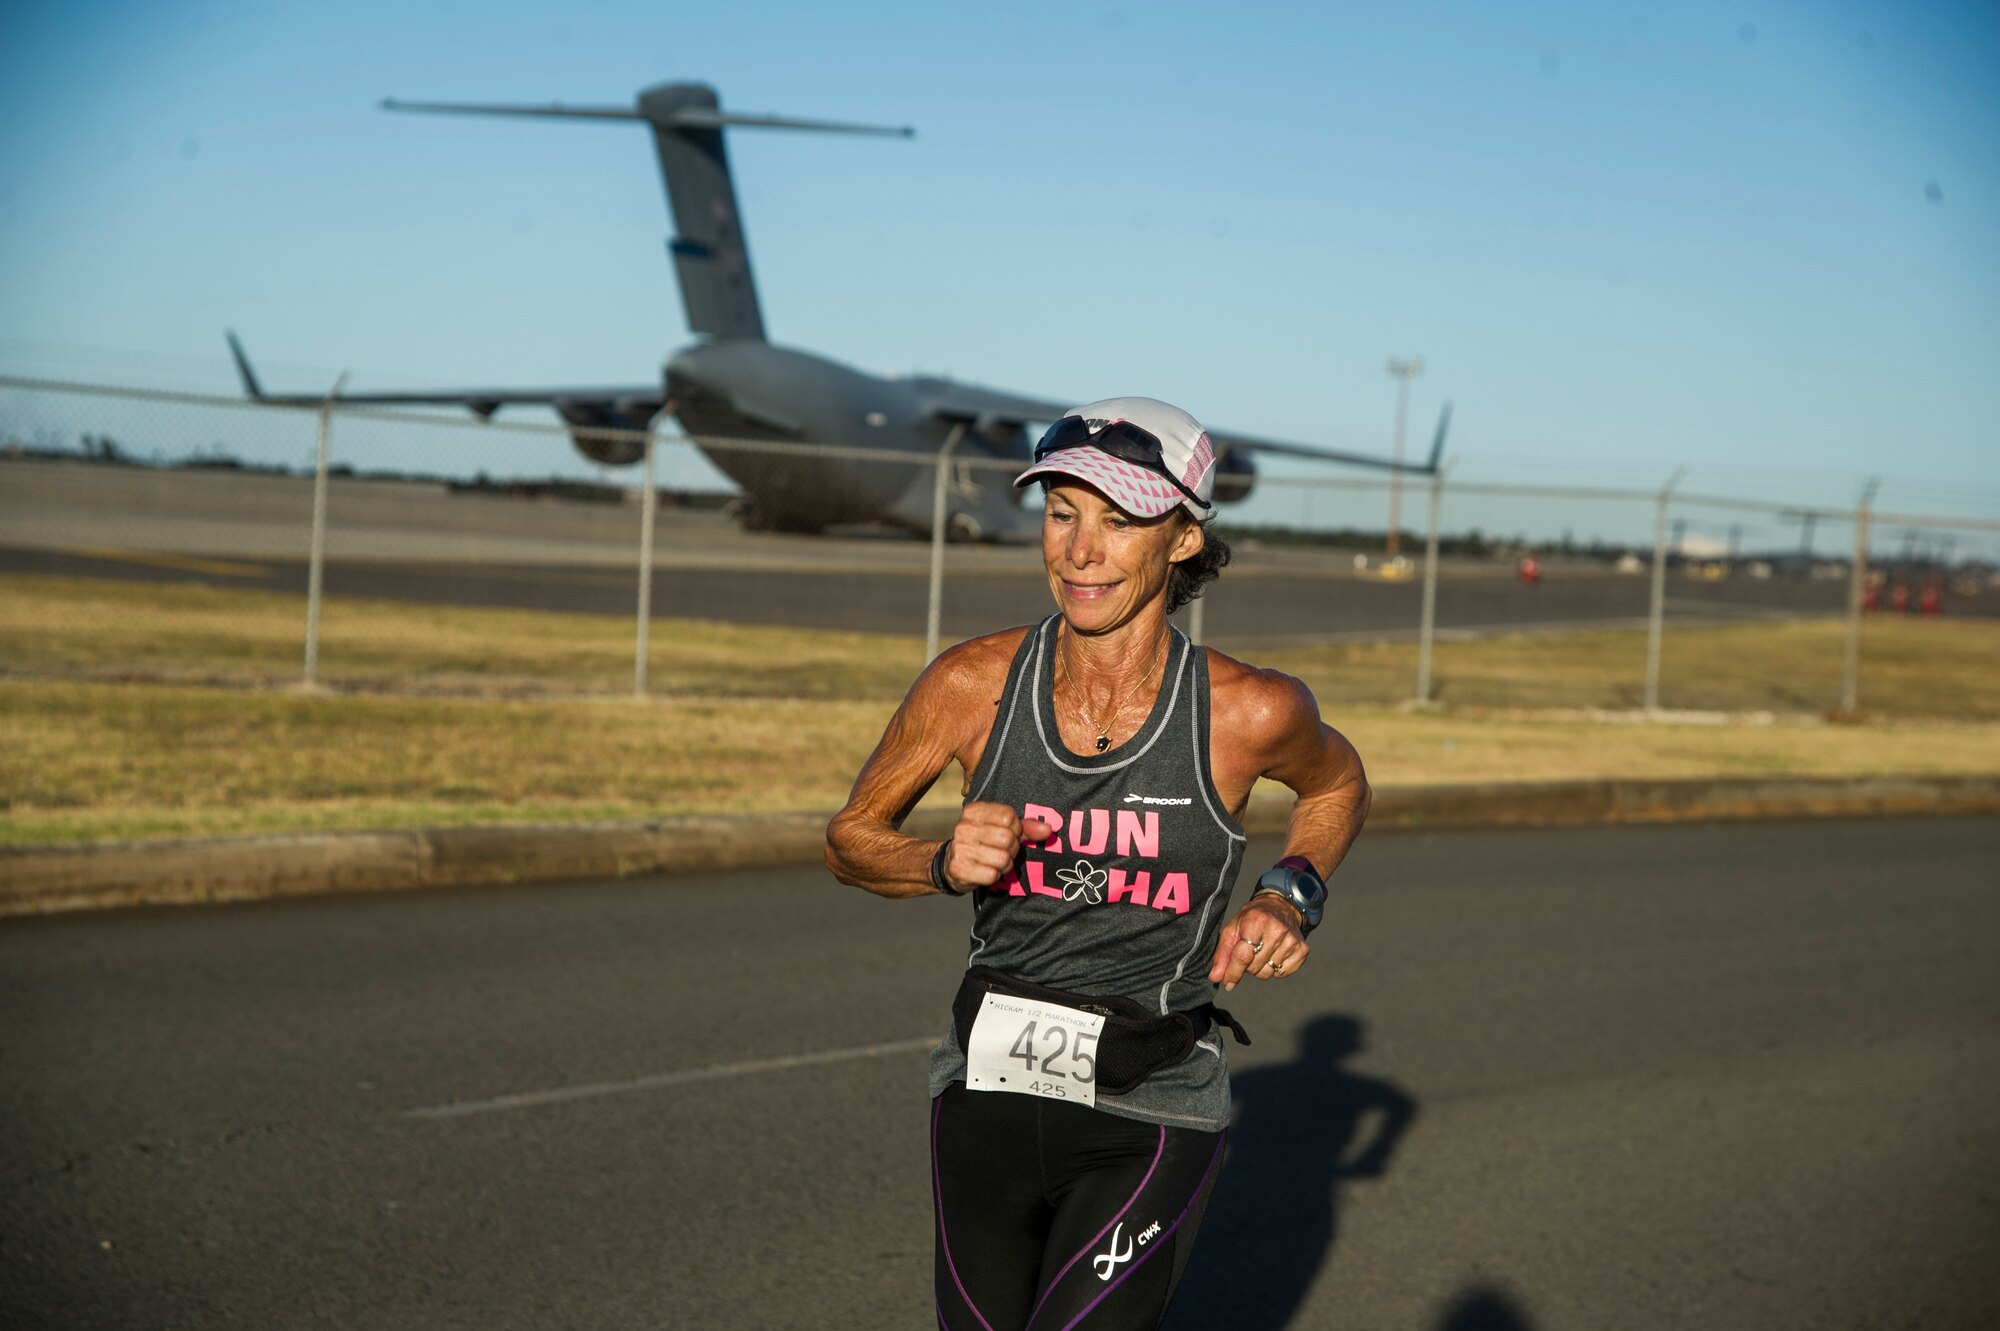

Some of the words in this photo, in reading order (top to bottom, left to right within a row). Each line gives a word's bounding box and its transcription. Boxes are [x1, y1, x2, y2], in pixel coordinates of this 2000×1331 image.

[1142, 796, 1192, 806] BROOKS
[1023, 802, 1160, 859] RUN
[994, 1003, 1024, 1014] HICKAM
[1027, 1009, 1042, 1017] 1/2
[1045, 1012, 1087, 1028] MARATHON
[1009, 1020, 1098, 1084] 425
[1029, 1081, 1066, 1098] 425
